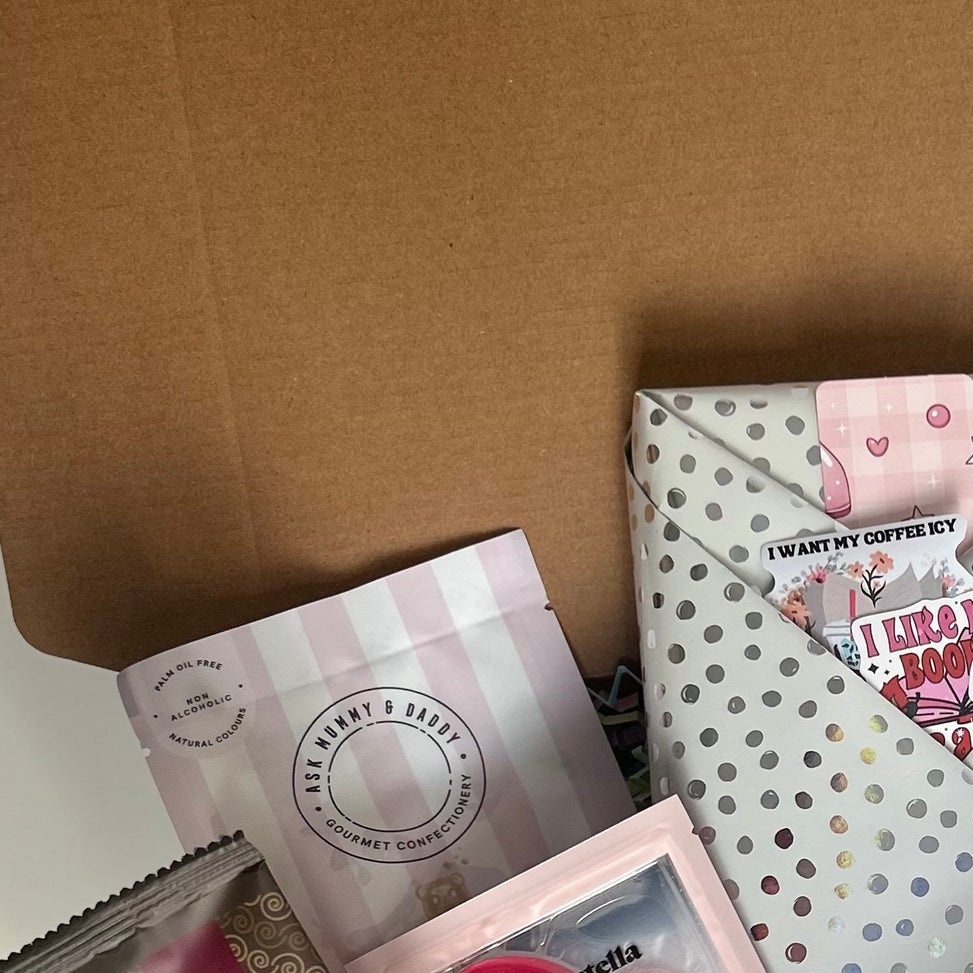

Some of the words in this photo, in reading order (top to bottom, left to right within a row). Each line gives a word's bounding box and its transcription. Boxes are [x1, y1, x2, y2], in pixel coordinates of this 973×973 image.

[767, 546, 776, 560] I
[778, 538, 830, 558] WANT
[833, 531, 861, 552] MY
[863, 524, 926, 546] COFFEE
[927, 518, 957, 536] ICY
[859, 623, 880, 658] I
[154, 669, 175, 692] PALM
[176, 661, 194, 671] OIL
[197, 659, 223, 671] FREE
[171, 694, 232, 721] ALCOHOLIC
[186, 692, 209, 705] NON
[168, 732, 214, 748] NATURAL
[215, 707, 247, 743] COLOURS
[304, 758, 324, 794] ASK
[314, 702, 373, 751] MUMMY
[385, 700, 395, 715] &
[406, 702, 462, 745] DADDY
[325, 817, 392, 851] GOURMET
[396, 773, 472, 851] CONFECTIONERY
